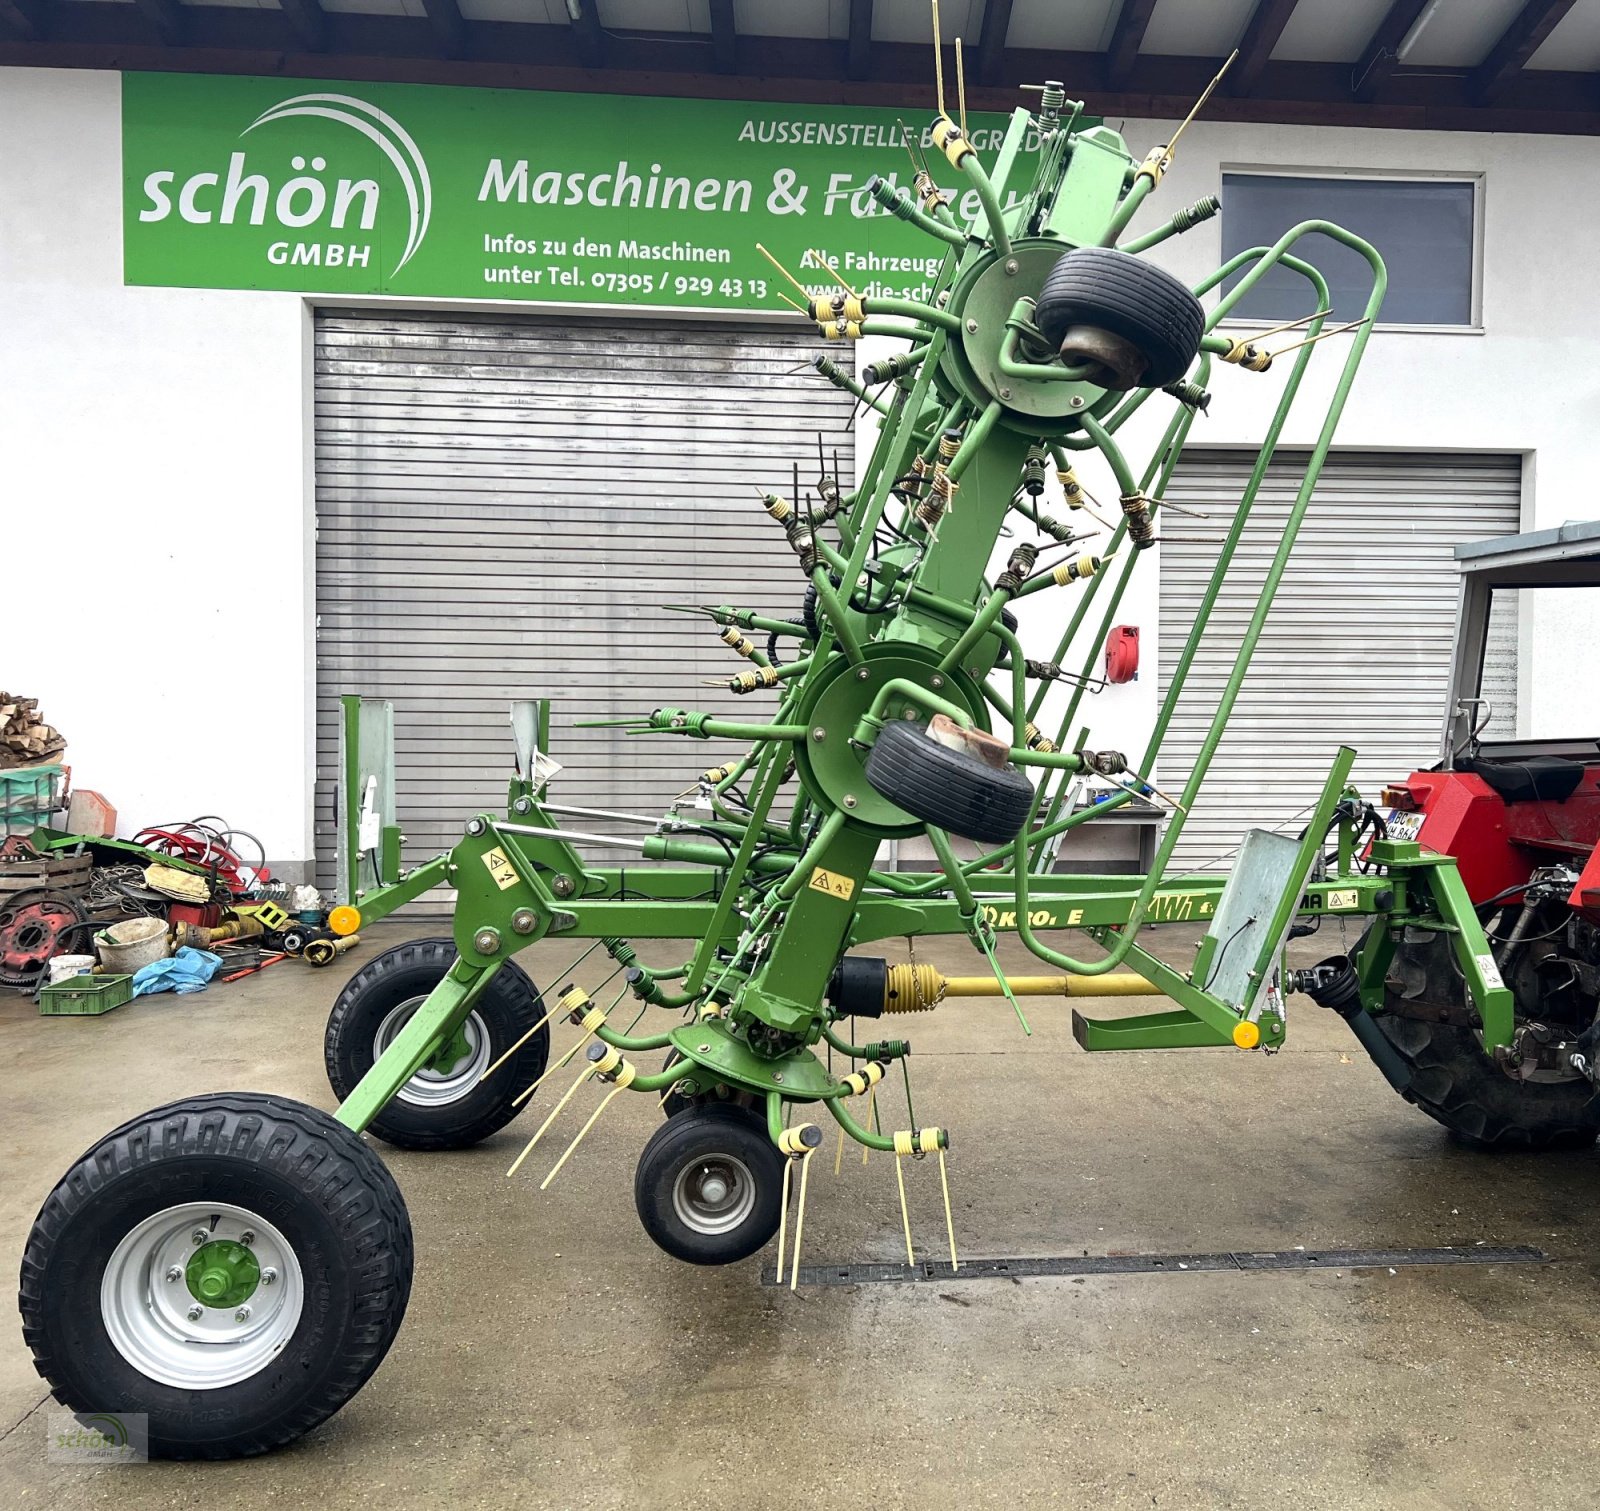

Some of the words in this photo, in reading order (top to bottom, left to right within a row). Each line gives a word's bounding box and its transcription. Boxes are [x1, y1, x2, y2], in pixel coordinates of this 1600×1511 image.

[737, 120, 915, 148] AUSSENSTELLE
[138, 151, 381, 231] schön
[477, 158, 753, 213] Maschinen
[766, 167, 810, 217] &
[266, 241, 371, 268] GMBH
[483, 232, 537, 255] Infos
[542, 240, 567, 256] zu
[572, 236, 613, 258] den
[617, 239, 731, 264] Maschinen
[799, 248, 839, 270] Alle
[483, 265, 543, 285] unter
[546, 265, 586, 287] Tel.
[590, 271, 654, 294] 07305
[658, 271, 670, 291] /
[674, 275, 714, 297] 929
[718, 278, 744, 299] 43
[747, 279, 768, 299] 13
[1394, 811, 1409, 825] BC
